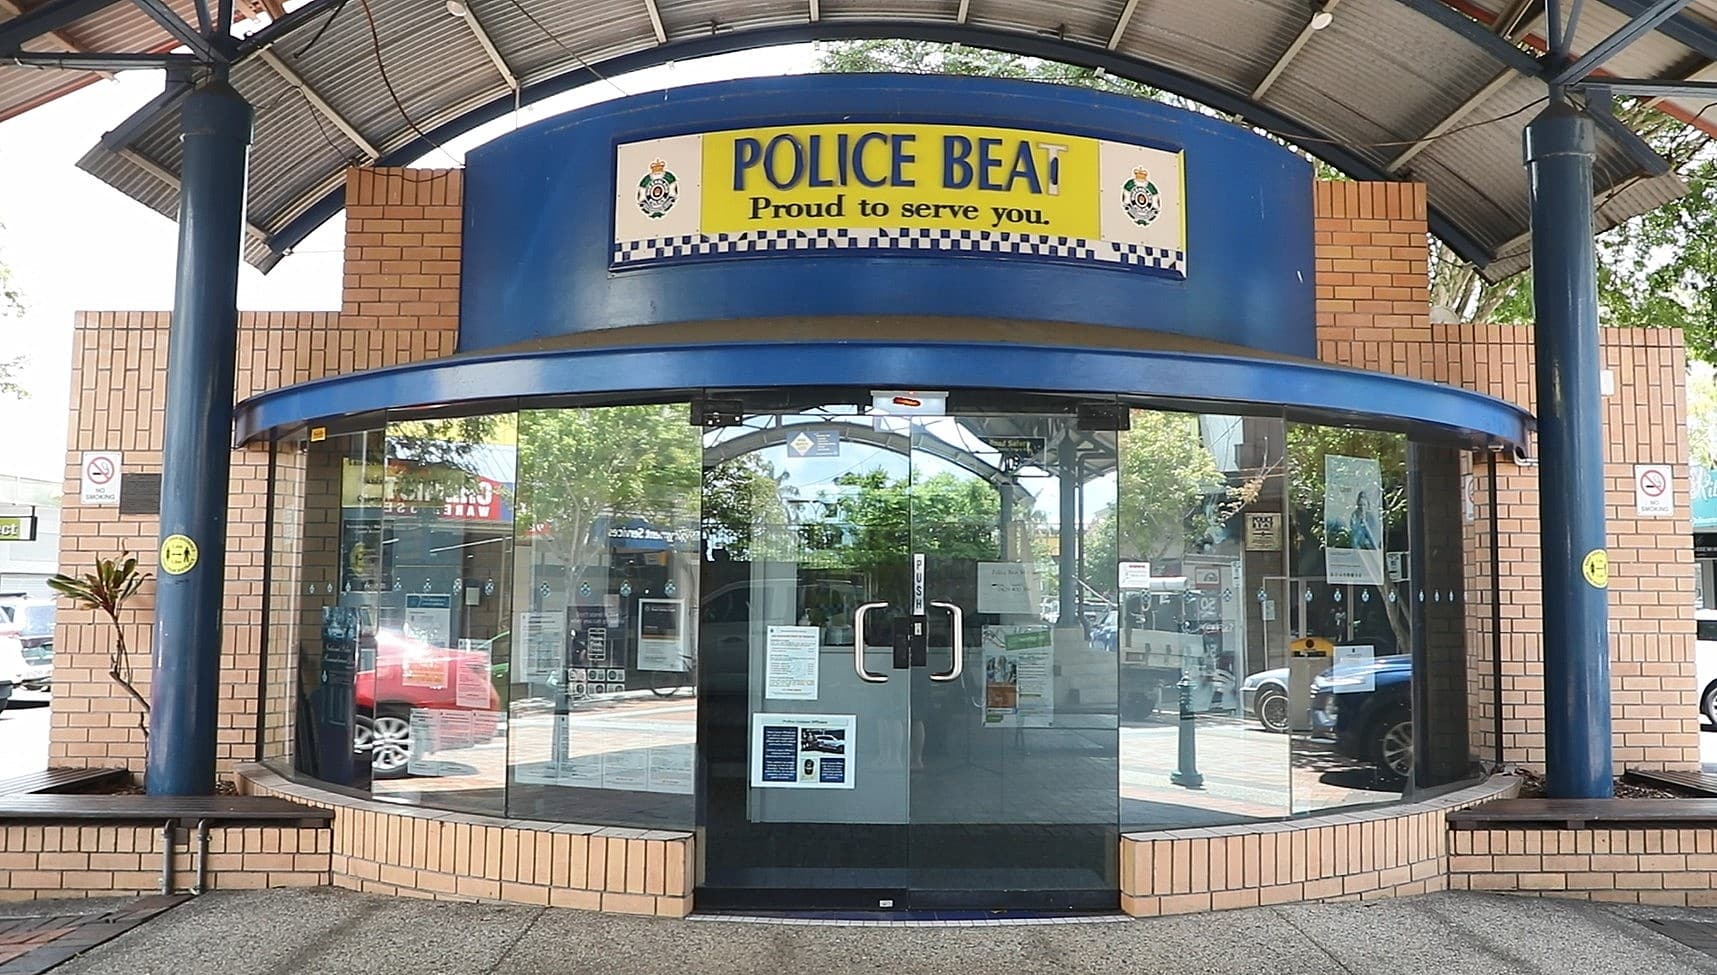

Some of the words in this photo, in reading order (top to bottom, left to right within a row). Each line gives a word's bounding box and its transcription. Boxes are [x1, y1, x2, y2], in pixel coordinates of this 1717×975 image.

[733, 131, 916, 192] POLICE
[943, 134, 1068, 196] BEAT
[748, 194, 845, 220] Proud
[858, 198, 889, 217] to
[901, 202, 979, 220] serve
[991, 206, 1050, 227] you.
[0, 523, 18, 536] ct
